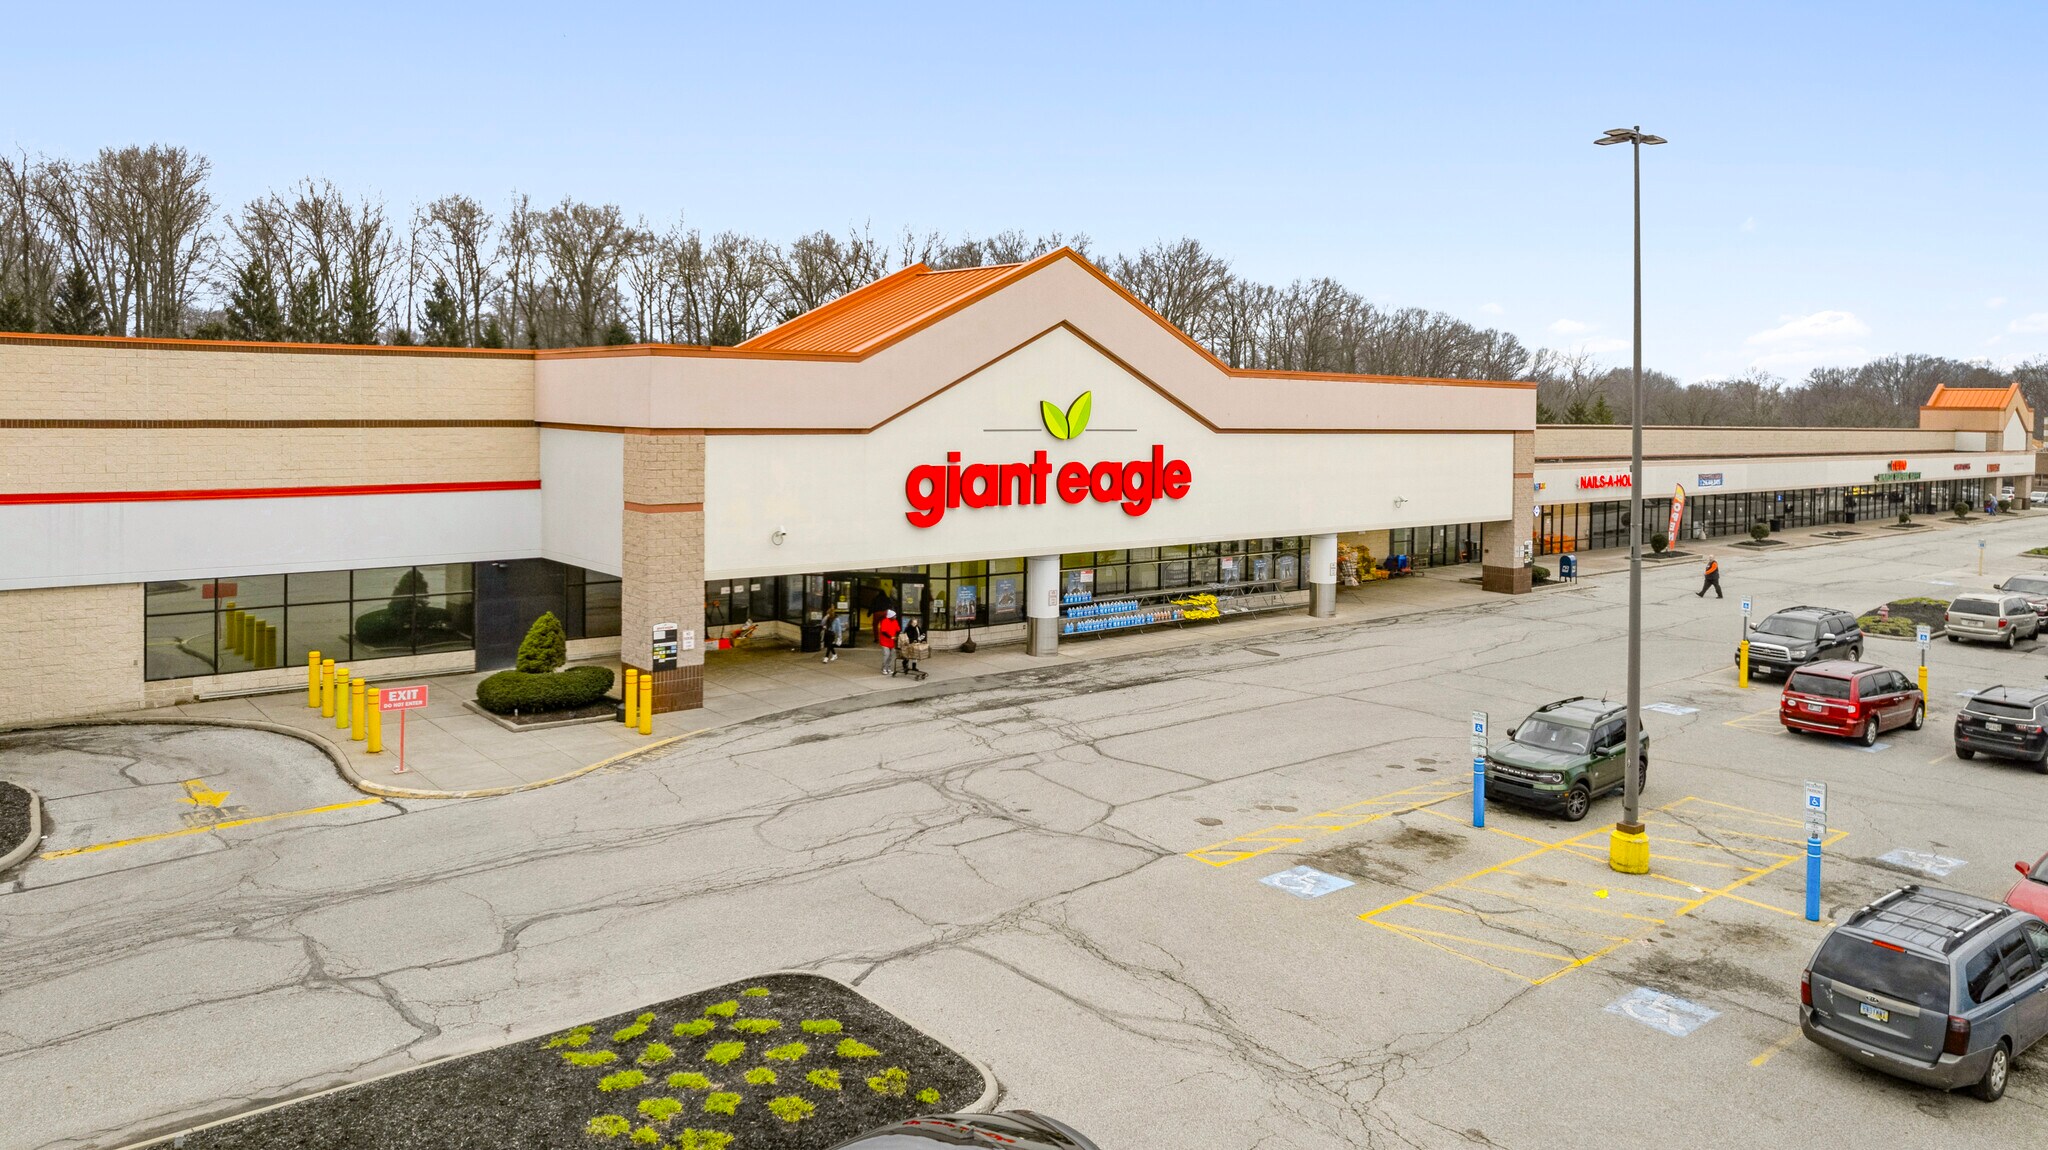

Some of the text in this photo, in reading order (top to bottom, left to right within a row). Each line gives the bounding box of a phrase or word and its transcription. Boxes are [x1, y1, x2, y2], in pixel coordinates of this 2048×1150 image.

[905, 444, 1192, 529] giant eagle
[1668, 503, 1681, 541] OPEN
[388, 689, 419, 702] EXIT
